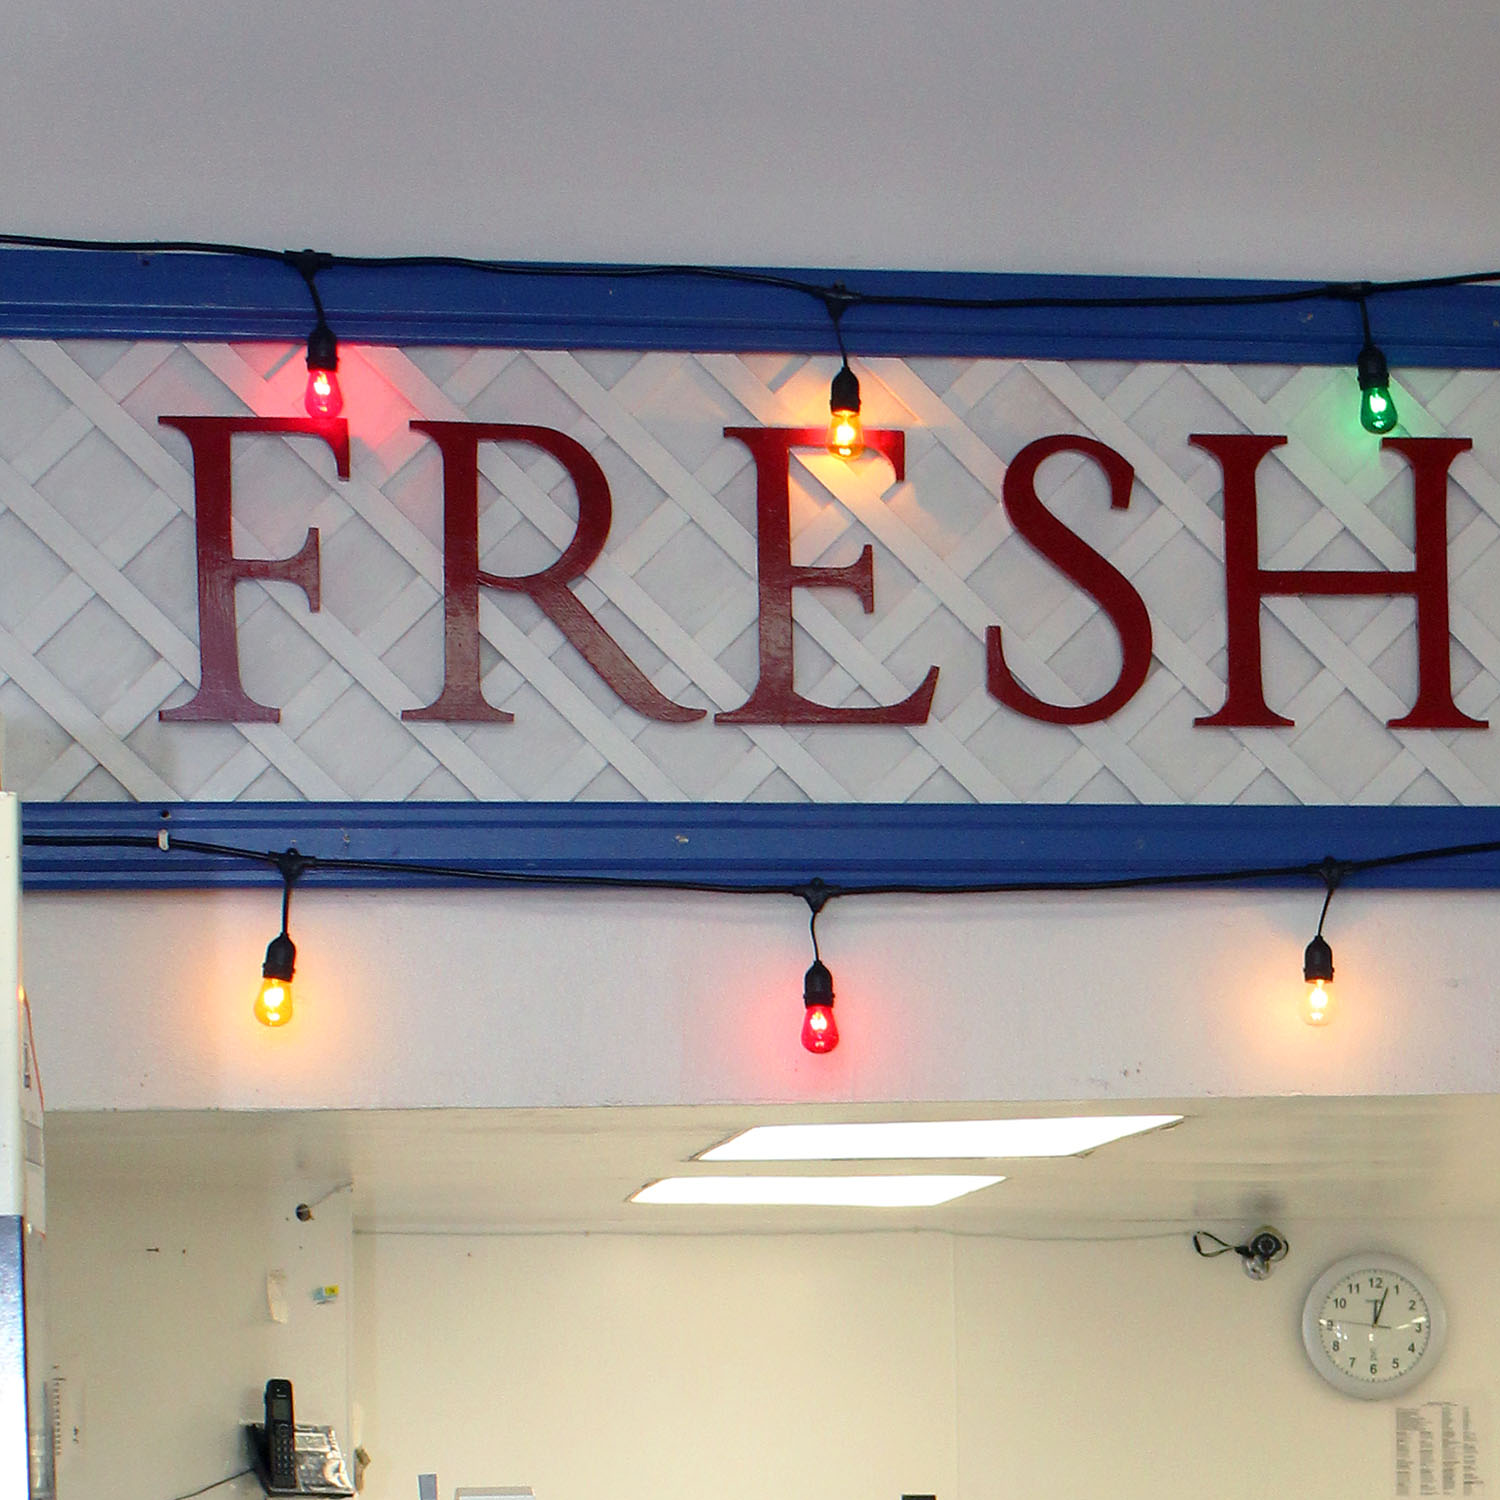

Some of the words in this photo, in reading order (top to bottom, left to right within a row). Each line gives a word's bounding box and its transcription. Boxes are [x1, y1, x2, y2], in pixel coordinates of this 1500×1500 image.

[157, 415, 1490, 730] FRESH
[1348, 1283, 1361, 1294] 11
[1368, 1278, 1383, 1289] 12
[1394, 1285, 1400, 1294] 1
[1333, 1298, 1347, 1309] 10
[1408, 1300, 1416, 1310] 2
[1415, 1322, 1422, 1333] 3
[1332, 1341, 1340, 1351] 8
[1408, 1342, 1416, 1352] 4
[1349, 1357, 1356, 1368] 7
[1392, 1358, 1400, 1369] 5
[1370, 1363, 1377, 1374] 6
